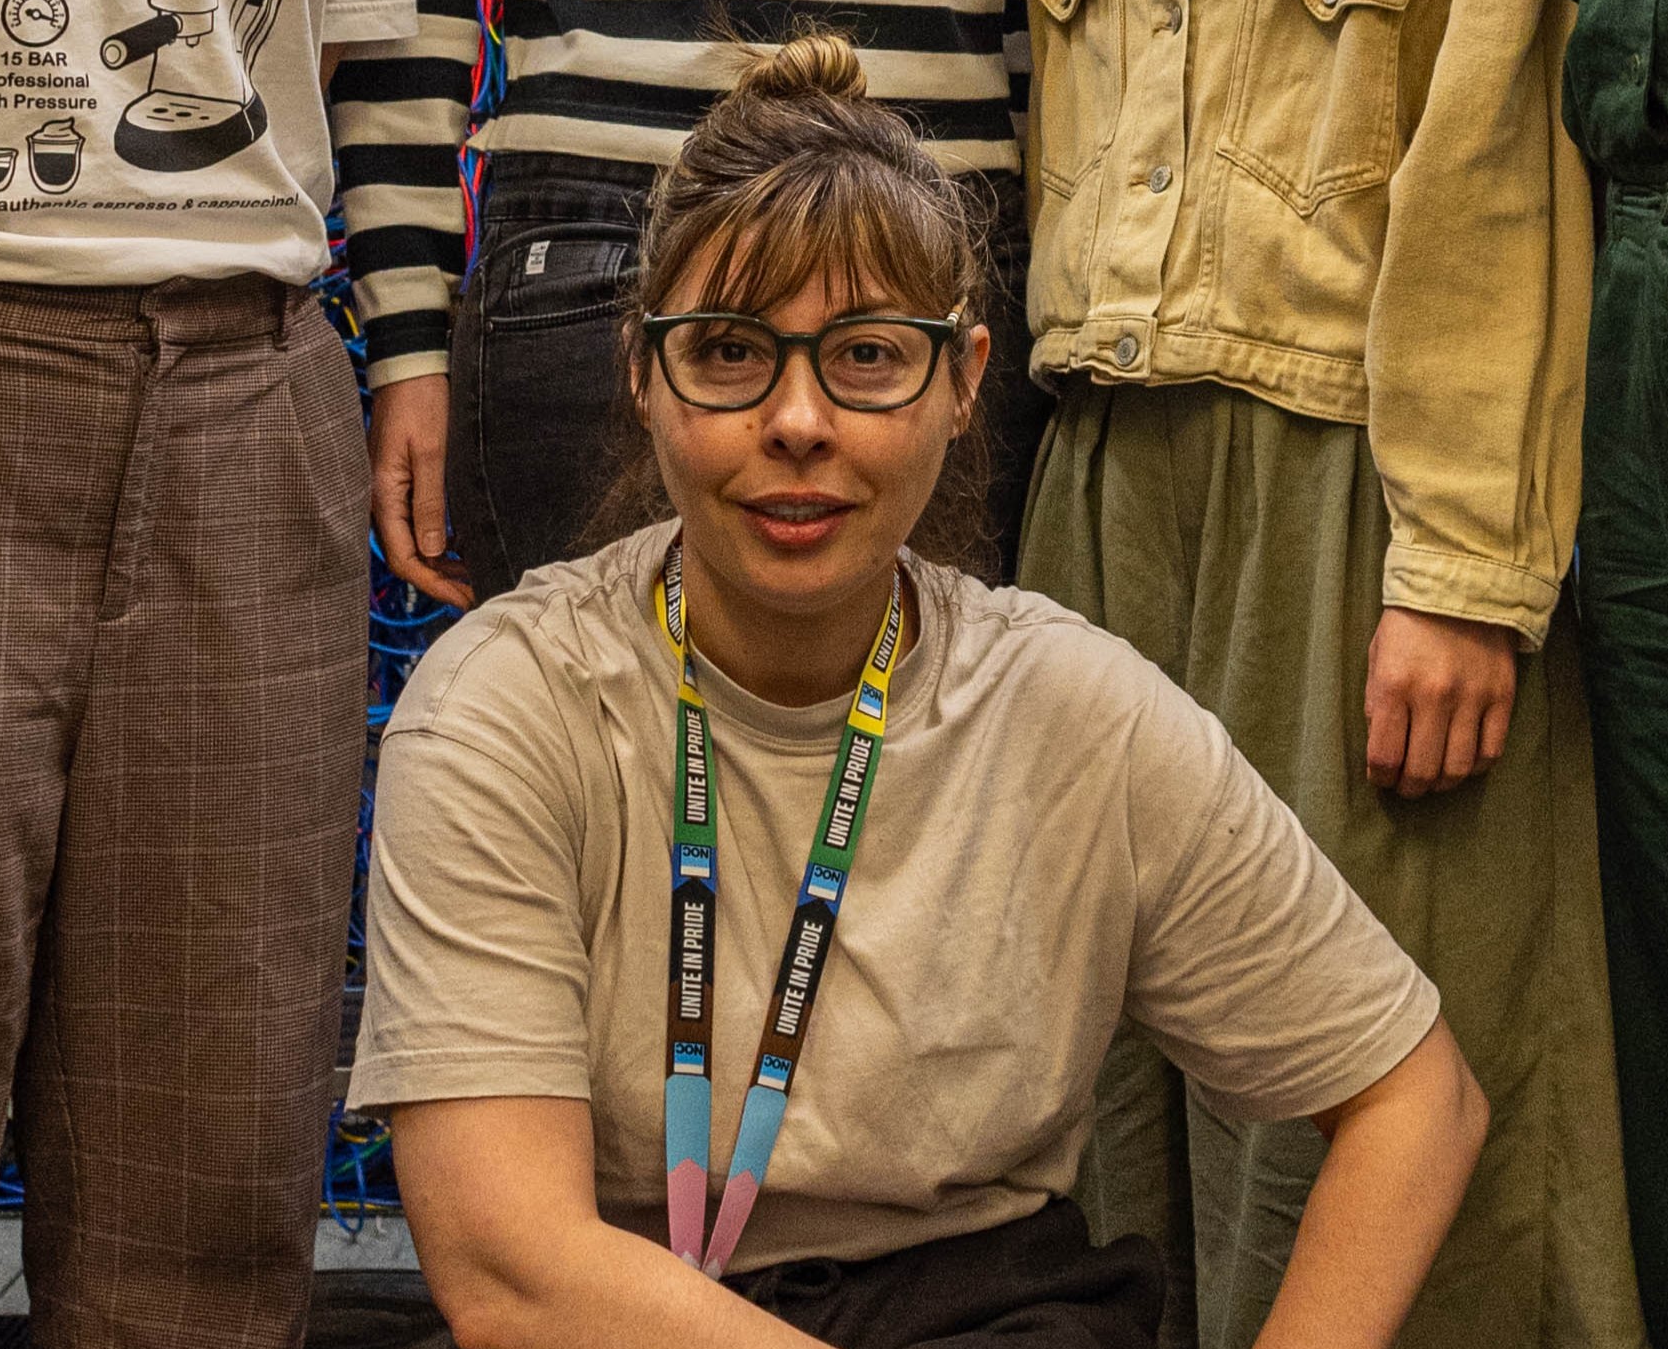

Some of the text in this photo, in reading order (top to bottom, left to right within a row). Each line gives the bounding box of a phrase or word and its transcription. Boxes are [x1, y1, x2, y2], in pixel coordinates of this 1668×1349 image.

[0, 51, 68, 67] 15 BAR
[14, 94, 97, 111] Pressure
[92, 200, 178, 211] espresso
[182, 198, 195, 210] &
[197, 193, 300, 209] cappuccino!
[874, 627, 898, 669] UNITE
[890, 609, 900, 629] IN
[686, 709, 707, 823] UNITE IN PRIDE
[826, 735, 872, 848] UNITE IN PRIDE
[682, 846, 711, 860] NOC
[813, 866, 842, 883] NOC
[680, 901, 705, 1020] UNITE IN PRIDE
[775, 919, 824, 1036] UNITE IN PRIDE
[674, 1042, 704, 1057] NOC
[763, 1055, 791, 1072] NOC
